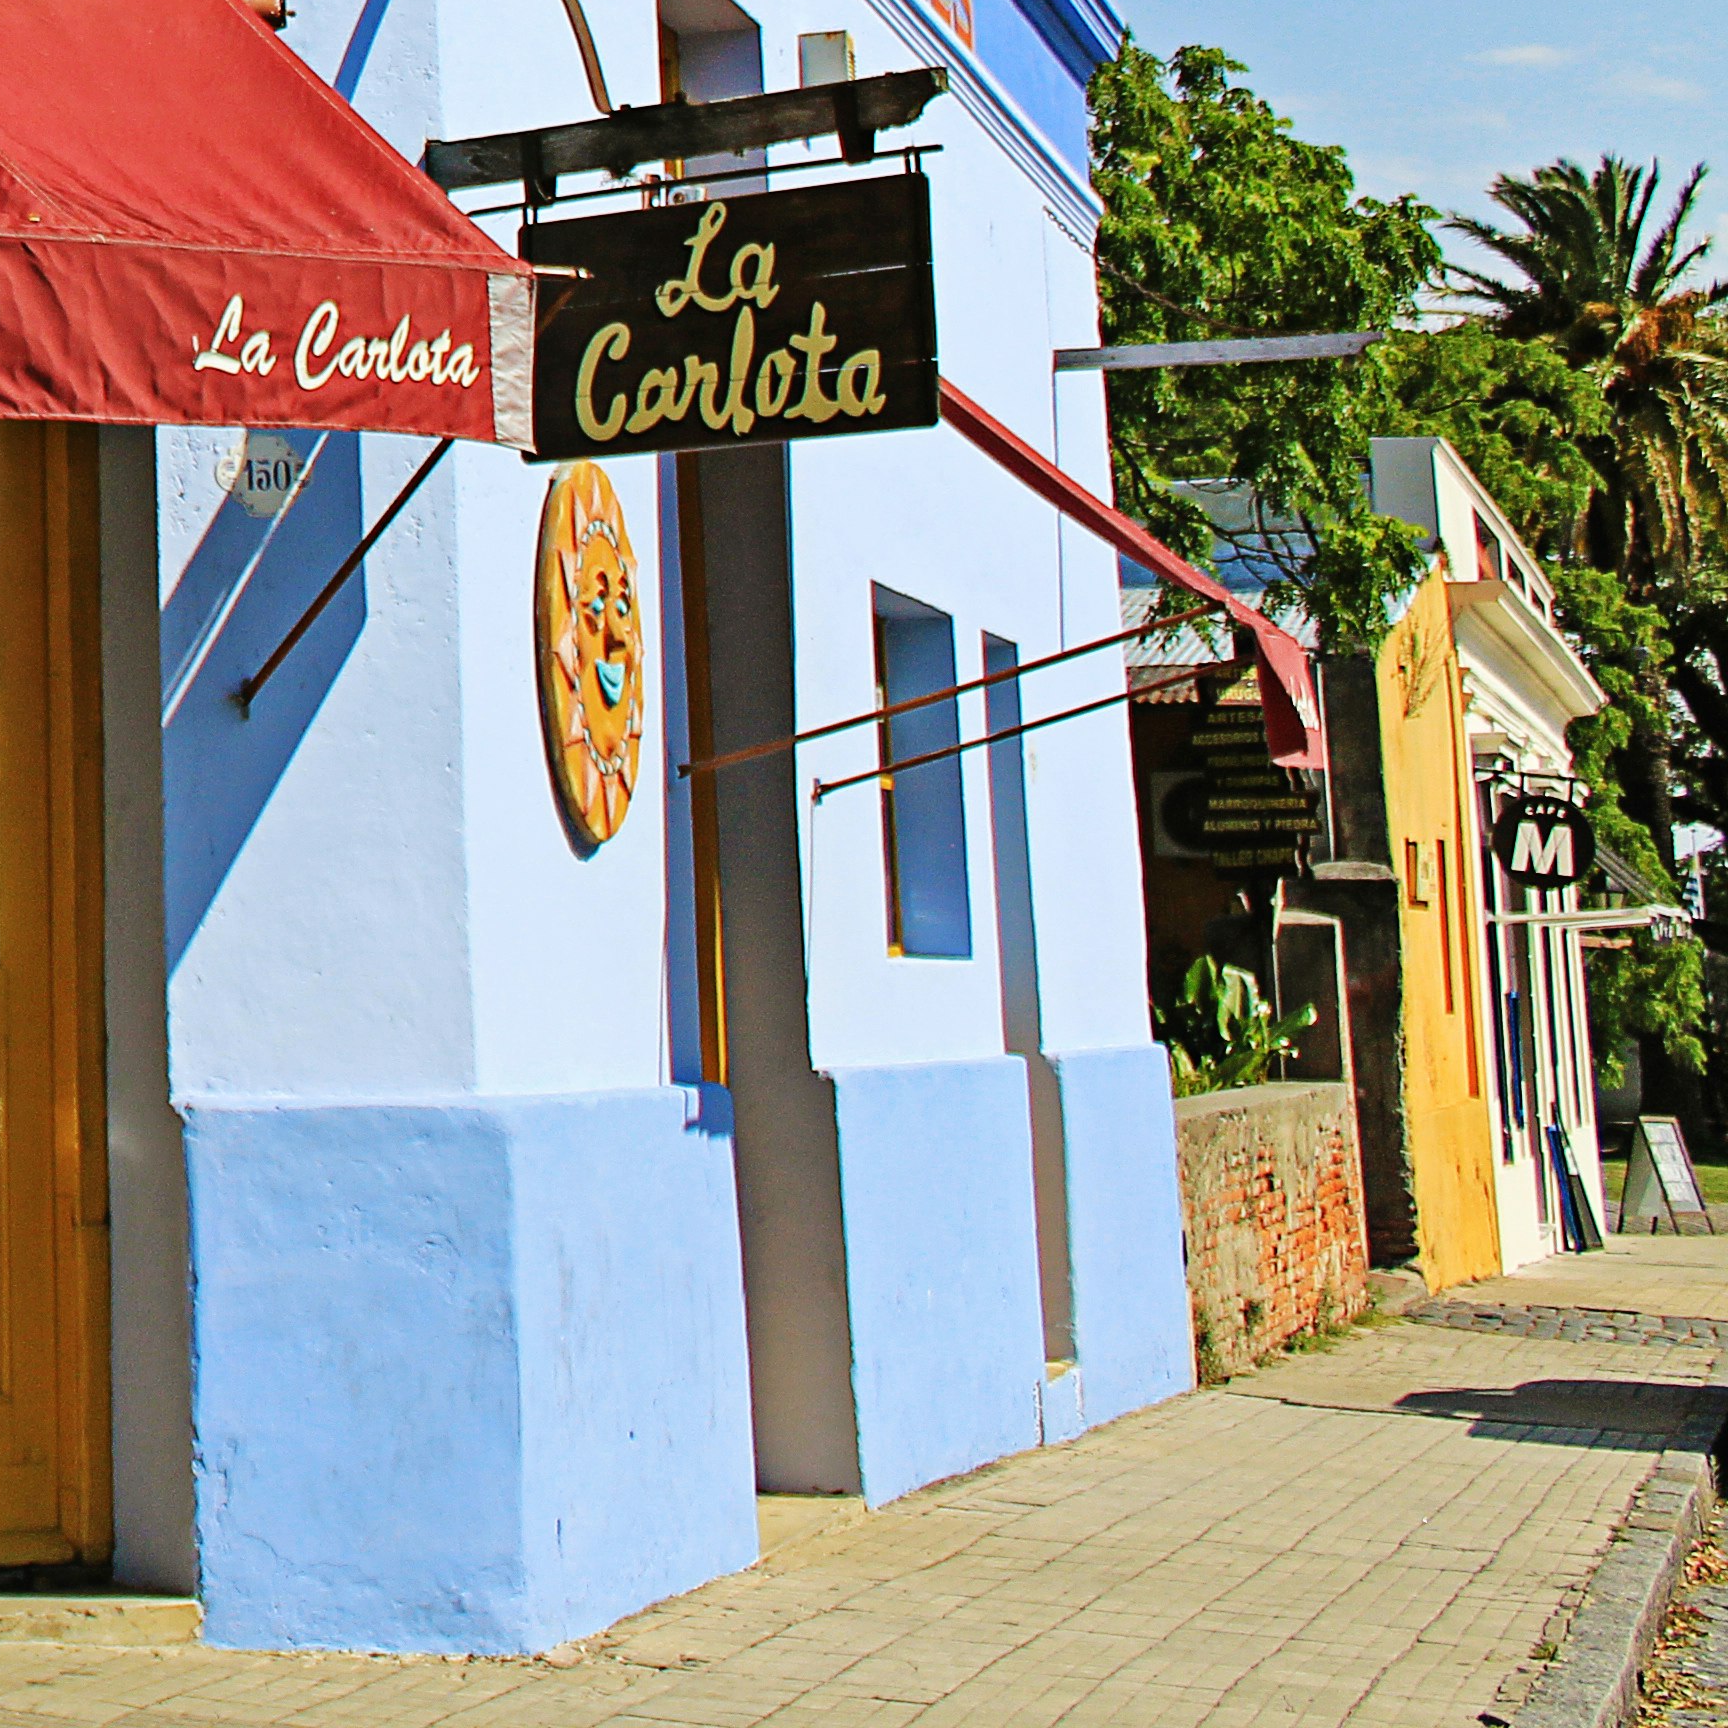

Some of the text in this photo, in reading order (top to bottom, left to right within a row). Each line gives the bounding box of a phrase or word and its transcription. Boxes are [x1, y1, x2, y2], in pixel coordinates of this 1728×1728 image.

[655, 201, 781, 318] La
[193, 293, 481, 391] La Carlota
[575, 304, 886, 442] Carlota
[244, 459, 292, 492] 150
[1510, 821, 1575, 878] M
